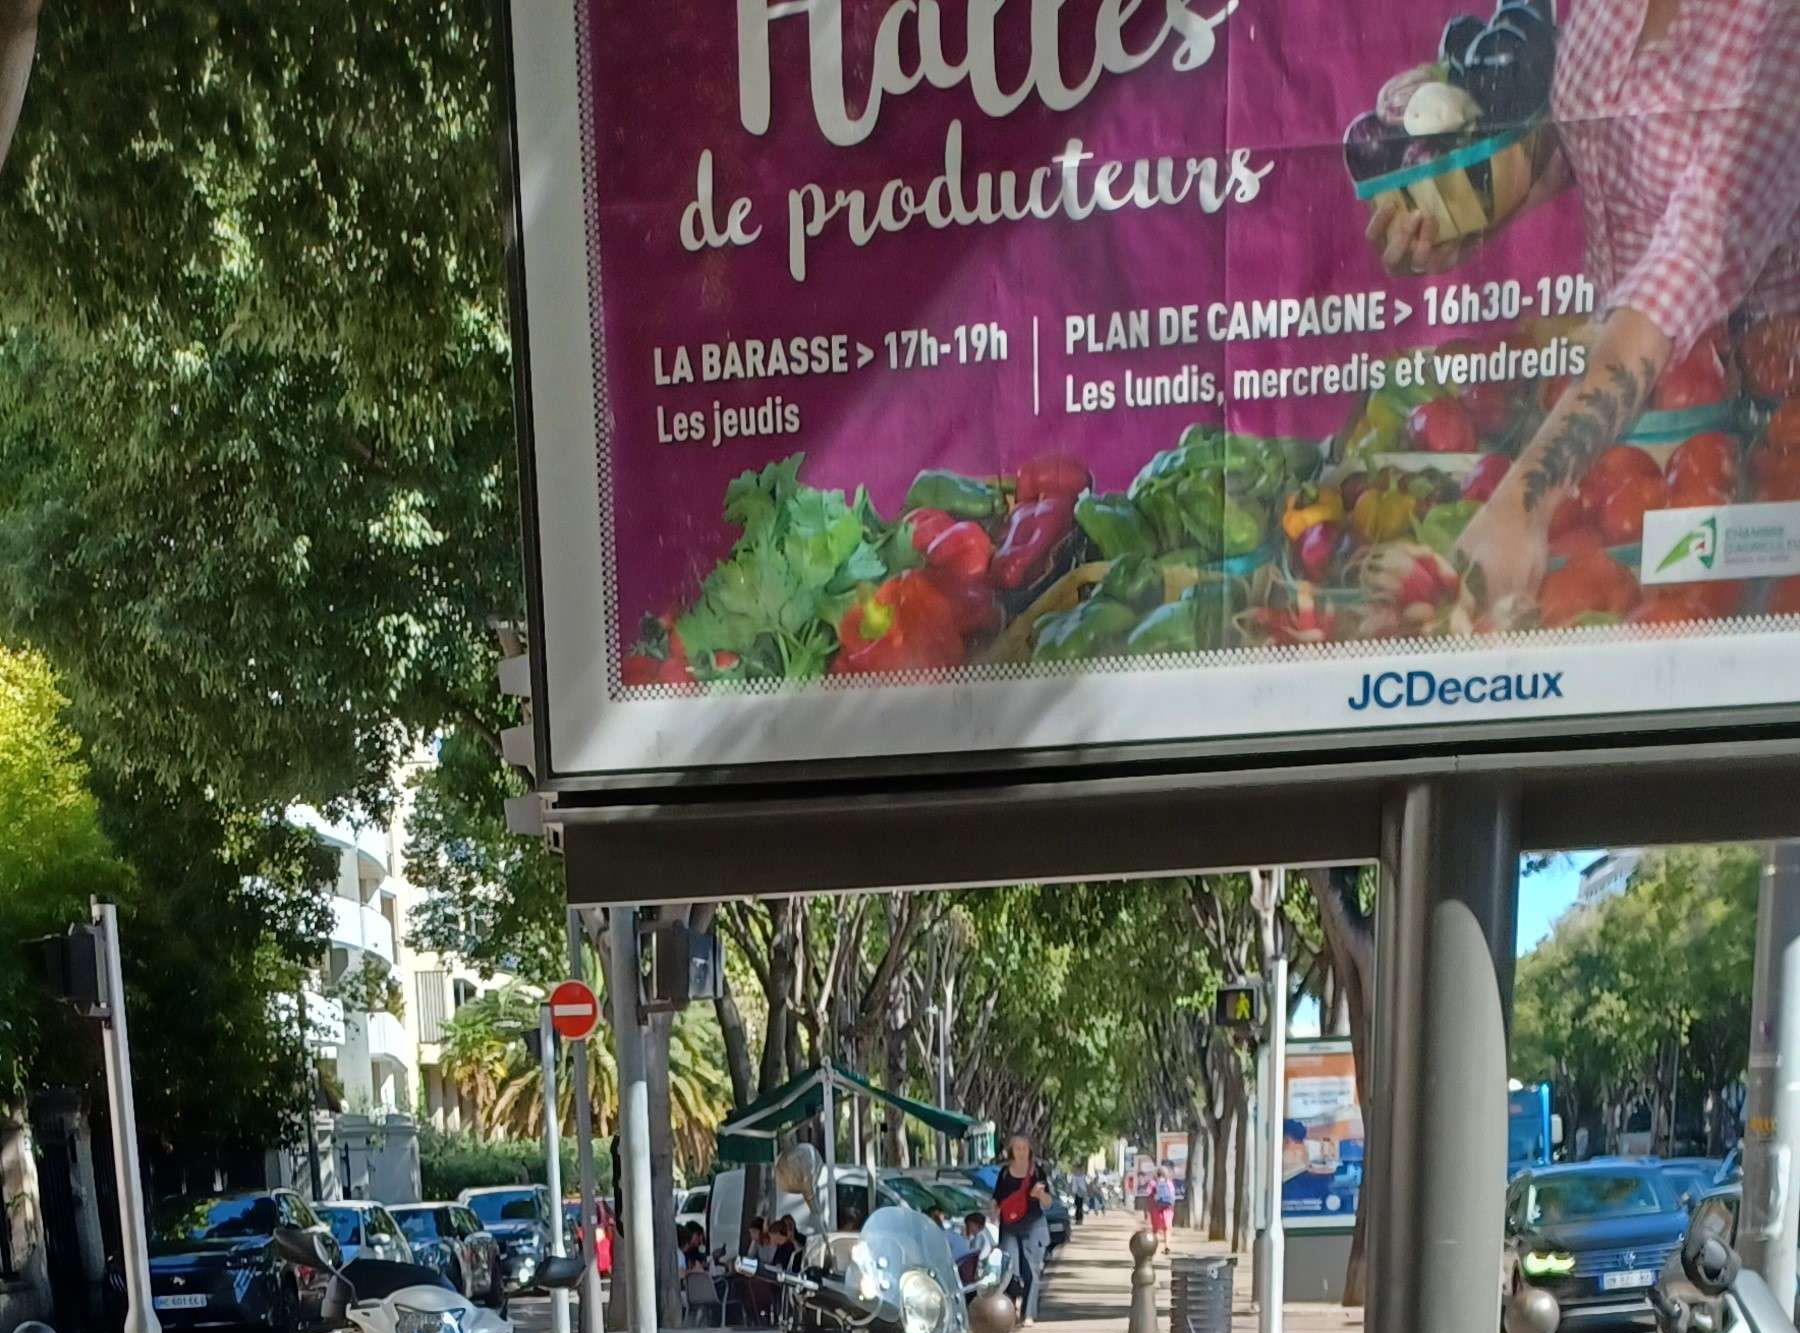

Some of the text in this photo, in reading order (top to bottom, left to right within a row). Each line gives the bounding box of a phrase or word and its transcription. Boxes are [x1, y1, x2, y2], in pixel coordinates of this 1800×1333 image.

[679, 118, 1276, 282] de producteurs
[1065, 308, 1151, 355] PLAN
[1158, 303, 1200, 346] DE
[1206, 290, 1387, 342] CAMPAGNE
[1423, 272, 1595, 327] 16h30-19h
[653, 345, 695, 386] LA
[701, 334, 849, 382] BARASSE
[883, 321, 1009, 370] 17h-19h
[1065, 336, 1586, 413] Les lundis, mercredis et vendredis
[656, 395, 801, 448] Les jeudis
[1347, 669, 1565, 711] JCDecaux
